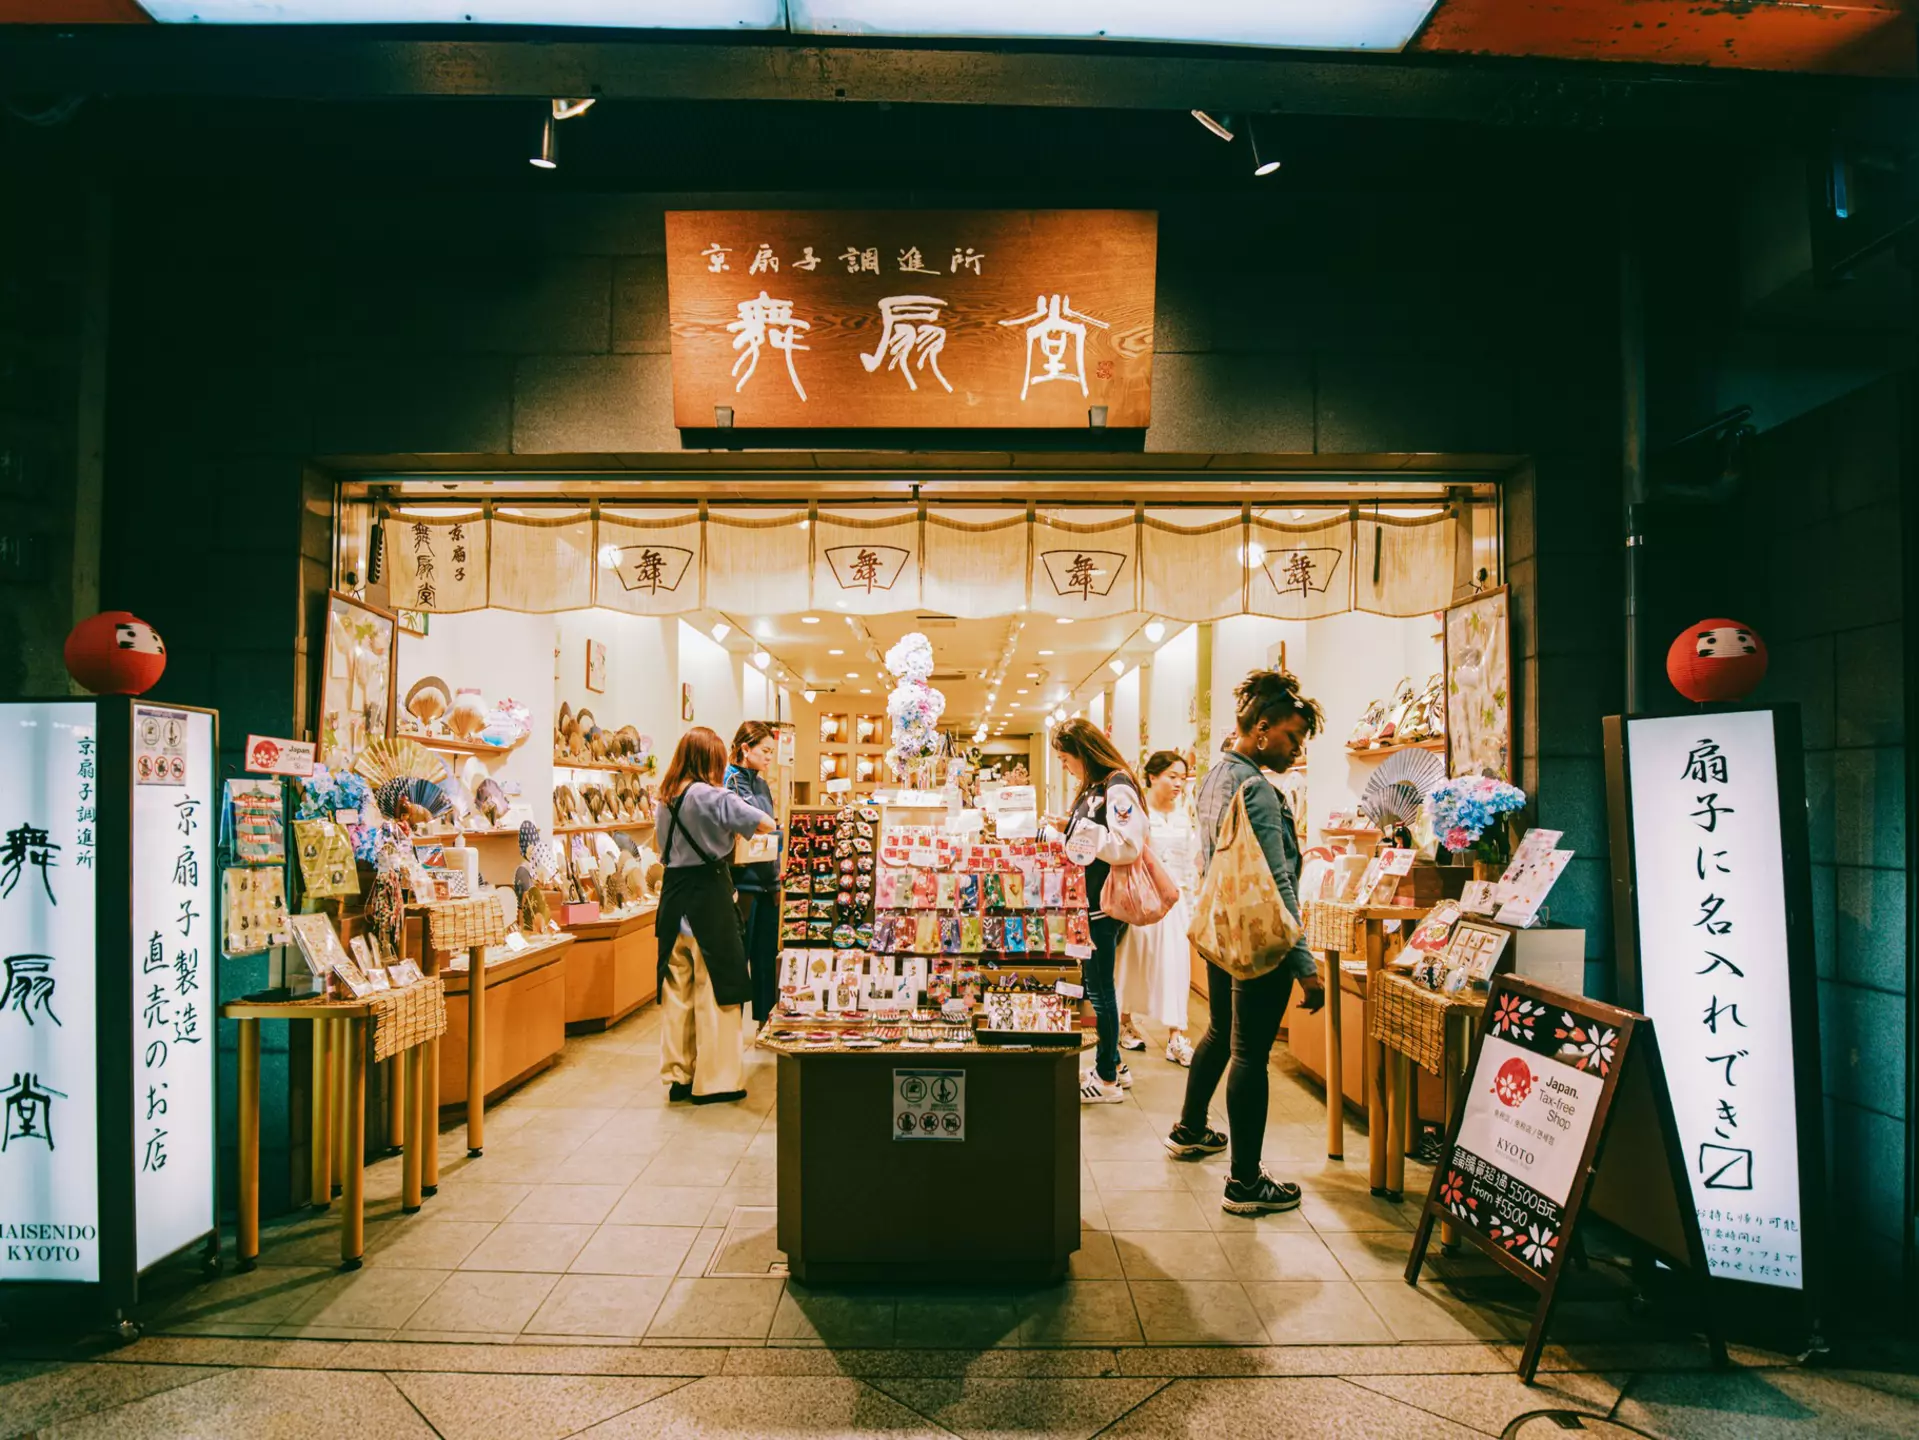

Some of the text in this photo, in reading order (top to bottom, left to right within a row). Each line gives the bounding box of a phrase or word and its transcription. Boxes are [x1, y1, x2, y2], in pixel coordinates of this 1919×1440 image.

[701, 243, 985, 275] 京扇子調進所
[726, 291, 1110, 401] 舞扇堂
[76, 736, 96, 869] 京扇子調進所
[171, 794, 202, 1044] 京扇子製造
[0, 822, 68, 1152] 舞扇堂
[142, 930, 170, 1173] 直売のお店
[1539, 1089, 1576, 1116] Tax-free
[1546, 1076, 1579, 1099] Japan.
[1546, 1109, 1571, 1131] Shop
[1496, 1137, 1535, 1165] KYOTO
[1470, 1180, 1493, 1203] From
[7, 1246, 80, 1262] KYOTO
